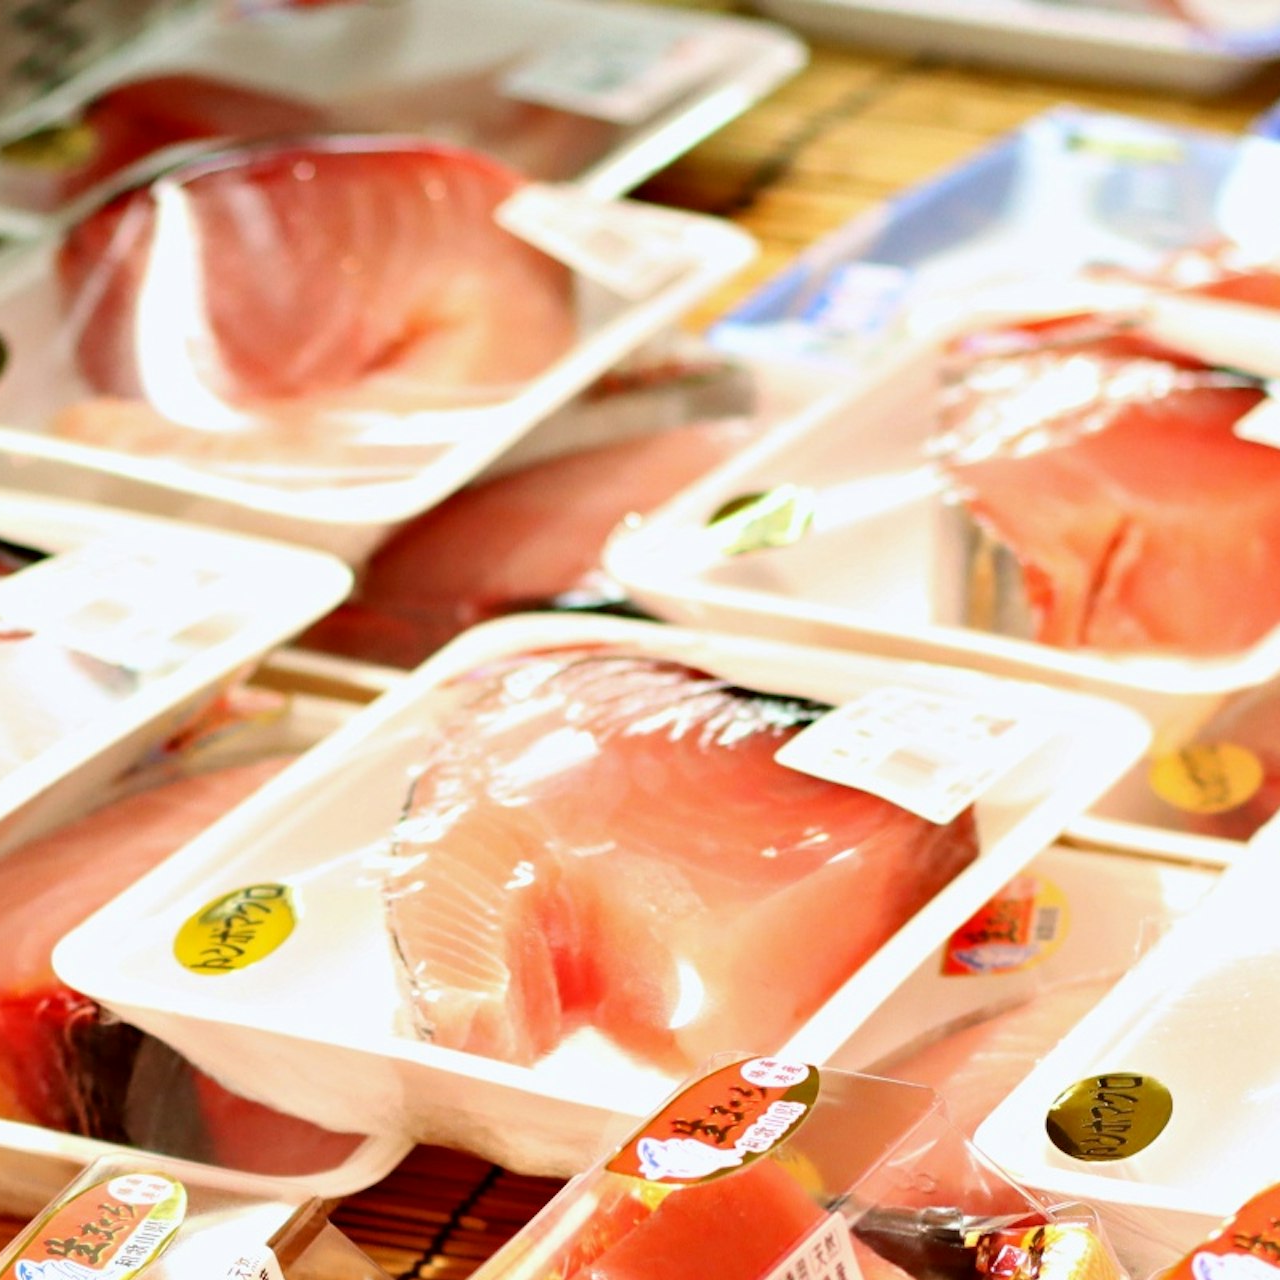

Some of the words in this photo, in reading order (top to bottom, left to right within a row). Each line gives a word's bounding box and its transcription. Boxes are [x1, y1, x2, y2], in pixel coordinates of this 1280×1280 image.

[672, 1086, 769, 1144] 生まぐろ
[1074, 1077, 1143, 1160] トンボマグロ
[44, 1202, 138, 1265] 生まぐろ
[115, 1220, 170, 1268] 和歌山県
